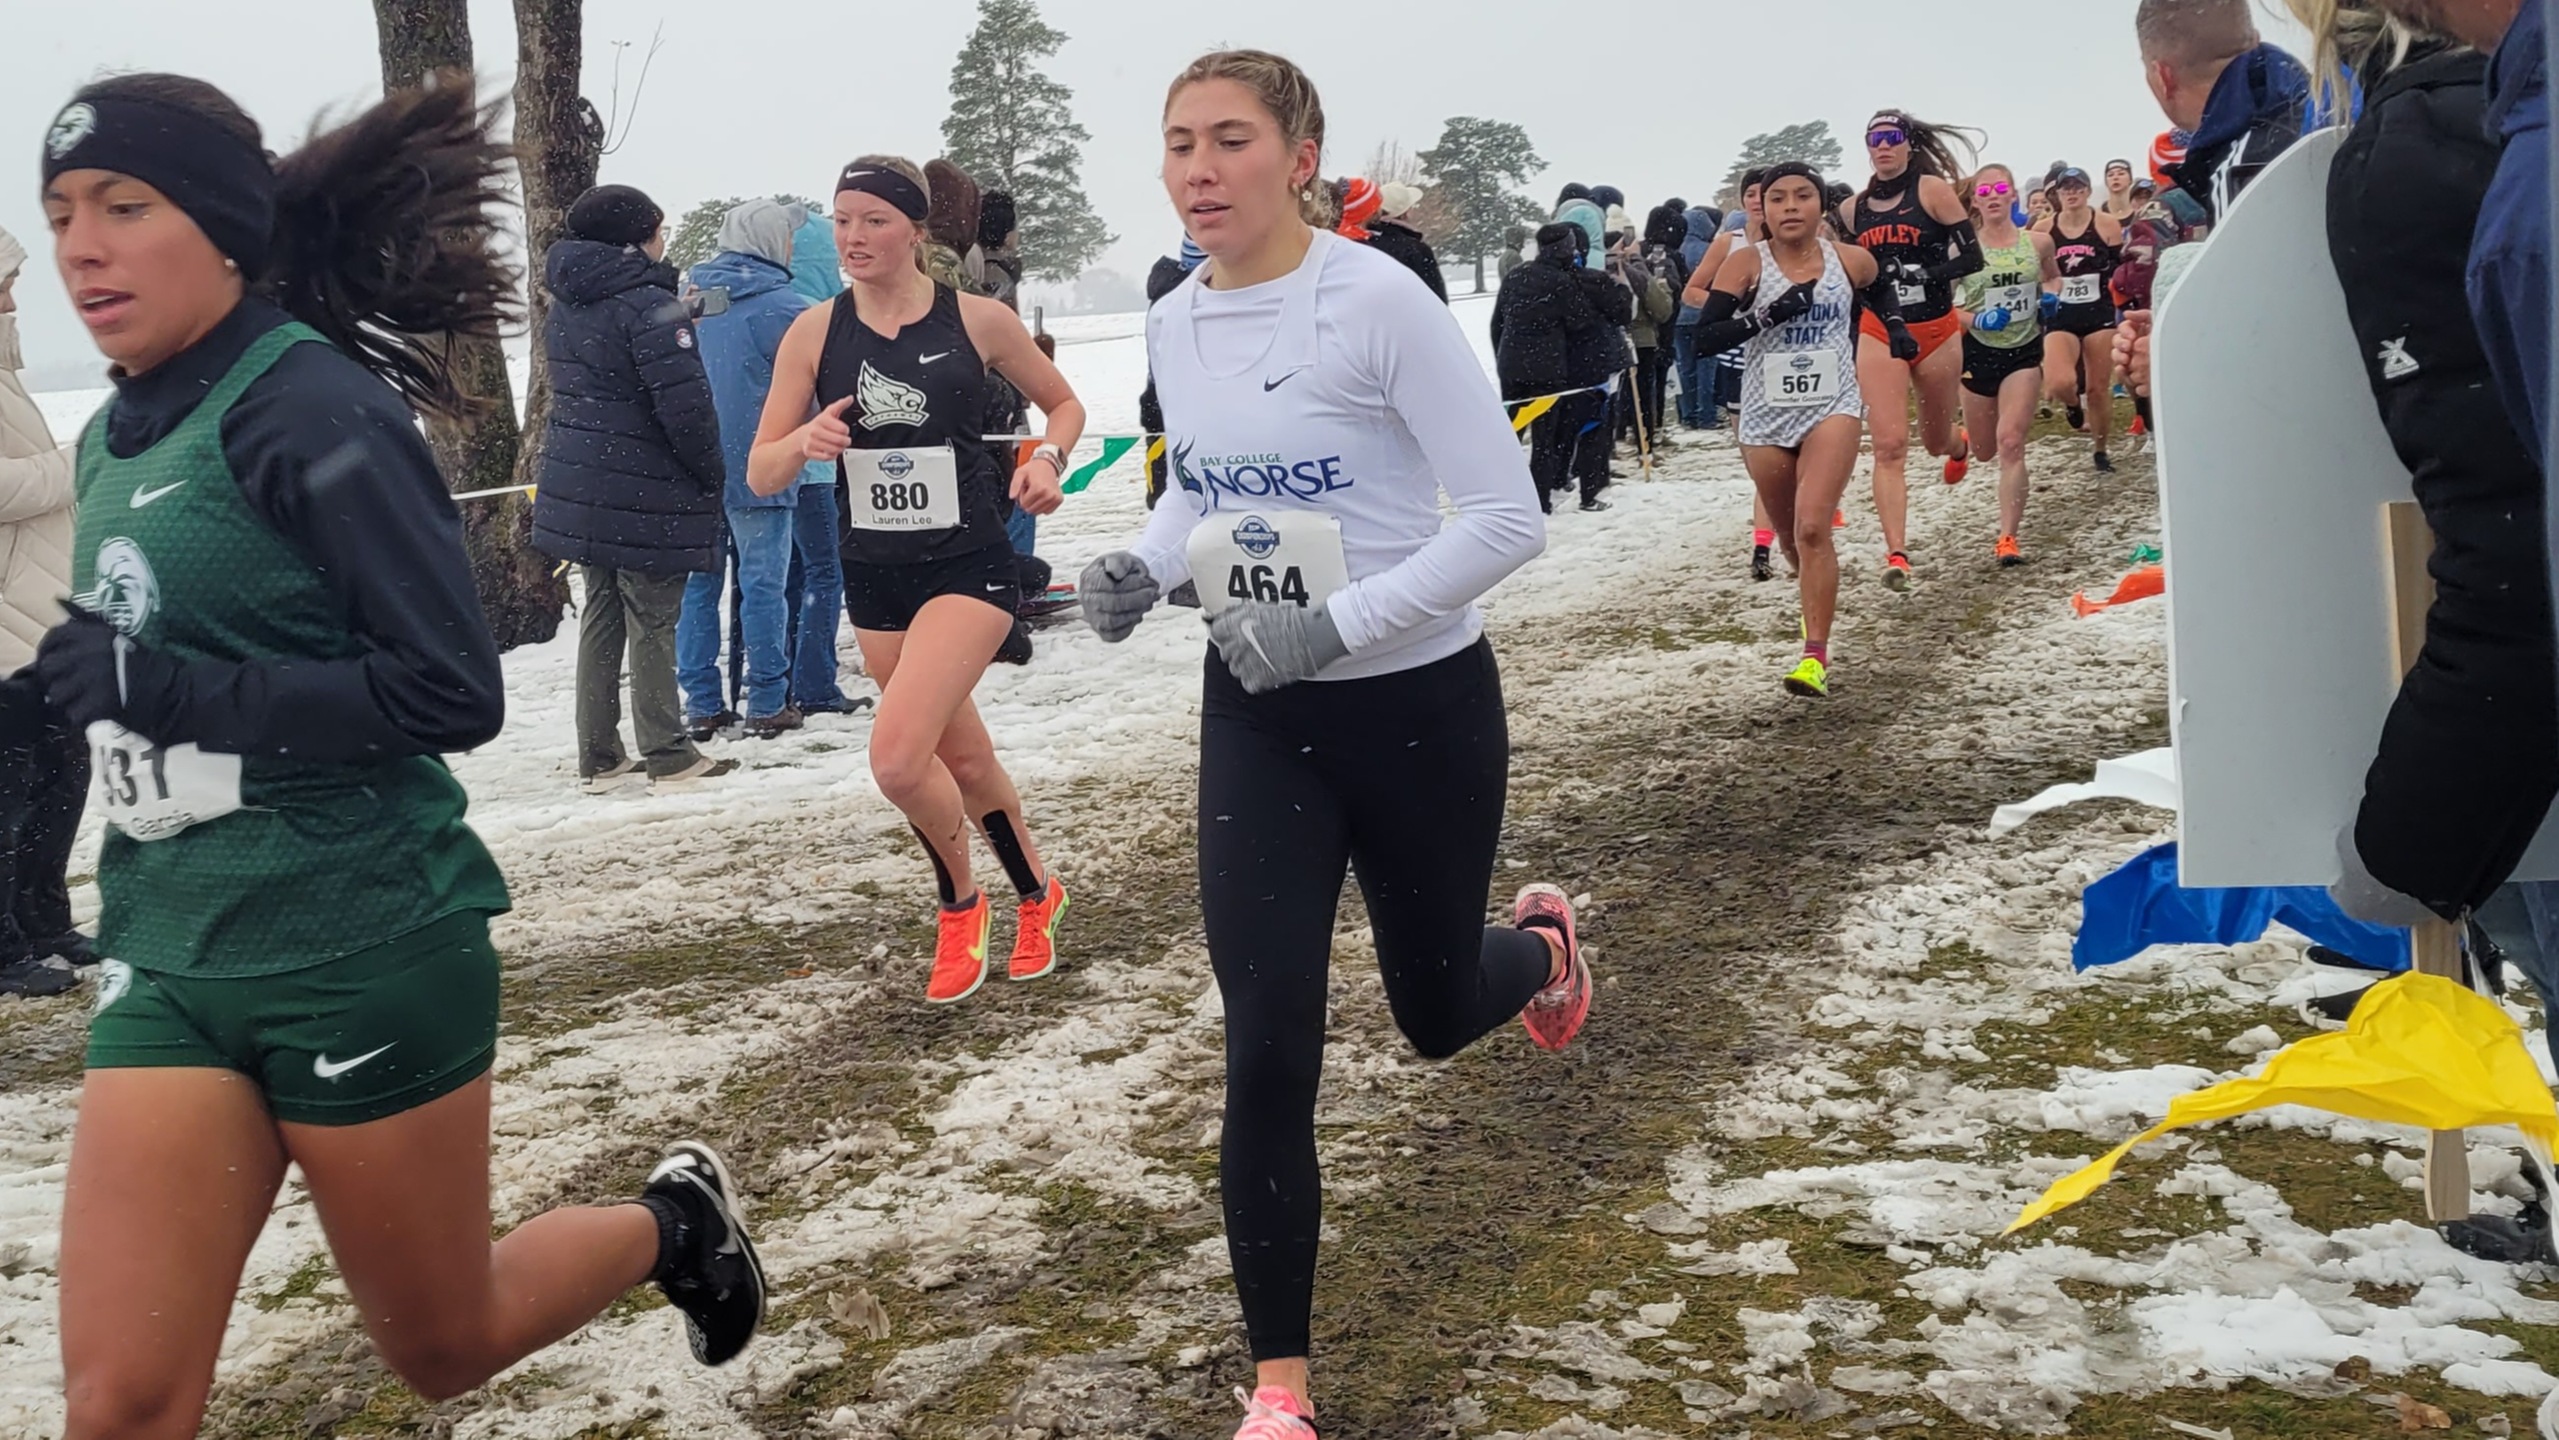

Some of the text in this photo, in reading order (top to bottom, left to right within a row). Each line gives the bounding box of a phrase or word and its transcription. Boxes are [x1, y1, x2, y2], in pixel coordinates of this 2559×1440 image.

[1992, 272, 2023, 287] SMC
[2066, 285, 2089, 297] 783
[1784, 326, 1826, 345] STATE
[1782, 373, 1821, 394] 567
[1200, 453, 1283, 467] BAY COLLEGE
[1202, 455, 1355, 509] NORSE
[870, 482, 929, 511] 880
[1228, 564, 1310, 608] 464
[101, 745, 170, 807] 31
